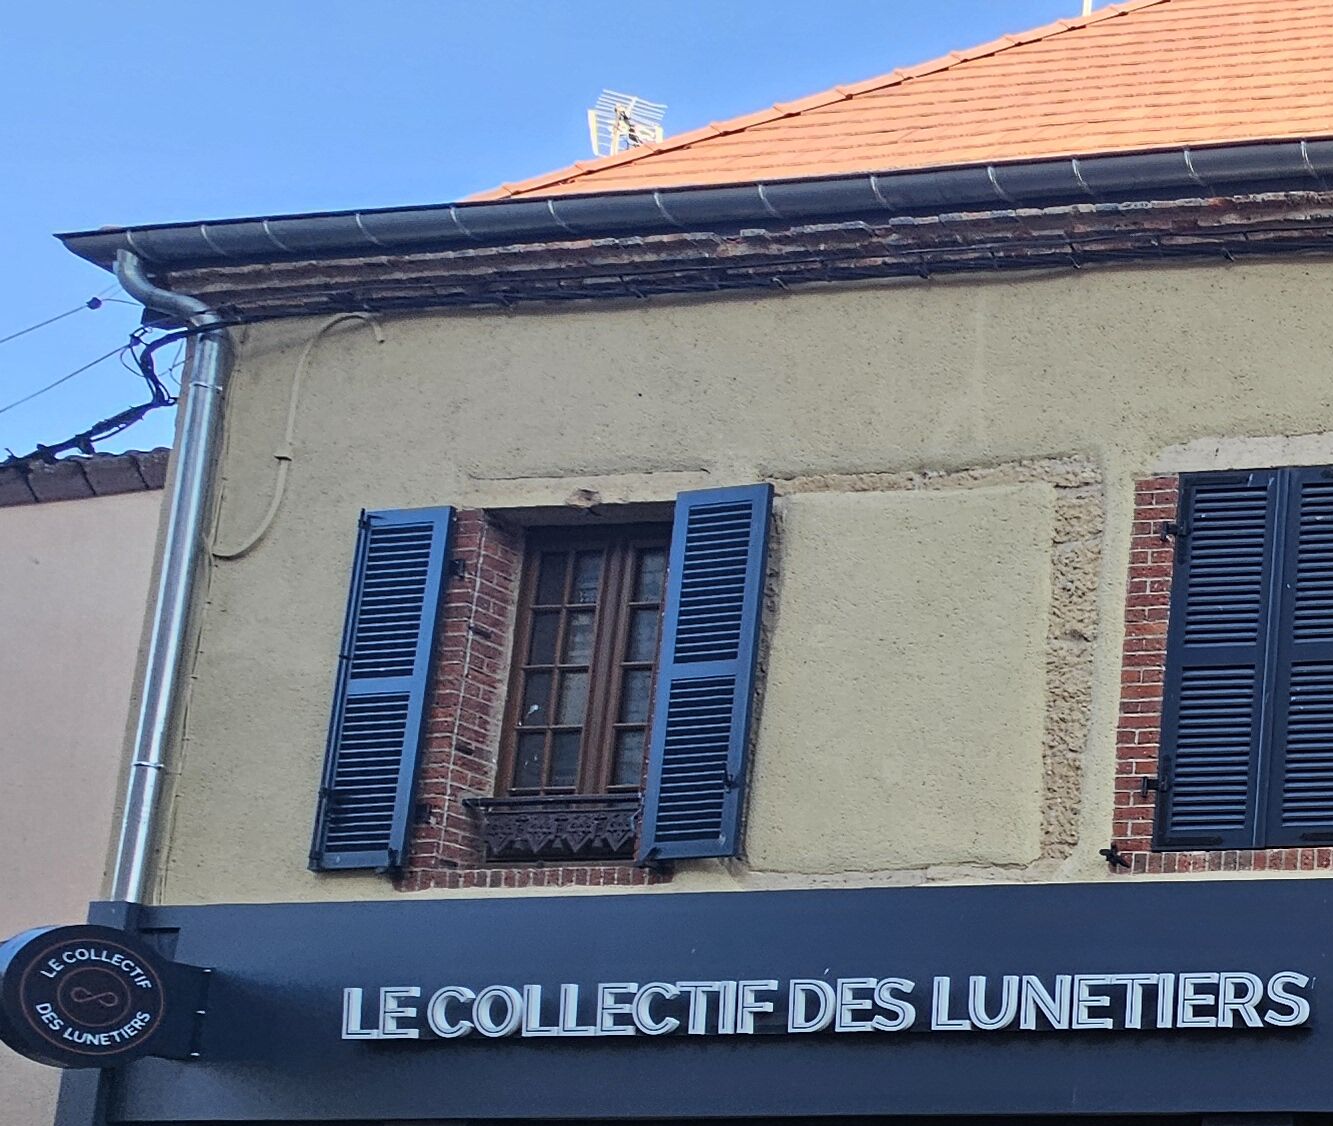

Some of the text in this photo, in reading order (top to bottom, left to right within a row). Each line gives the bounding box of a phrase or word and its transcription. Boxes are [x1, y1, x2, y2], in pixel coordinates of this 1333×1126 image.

[39, 948, 152, 989] LE COLLECTIF
[36, 1002, 151, 1046] DES LUNETIERS
[341, 970, 1311, 1039] LE COLLECTIF DES LUNETIERS
